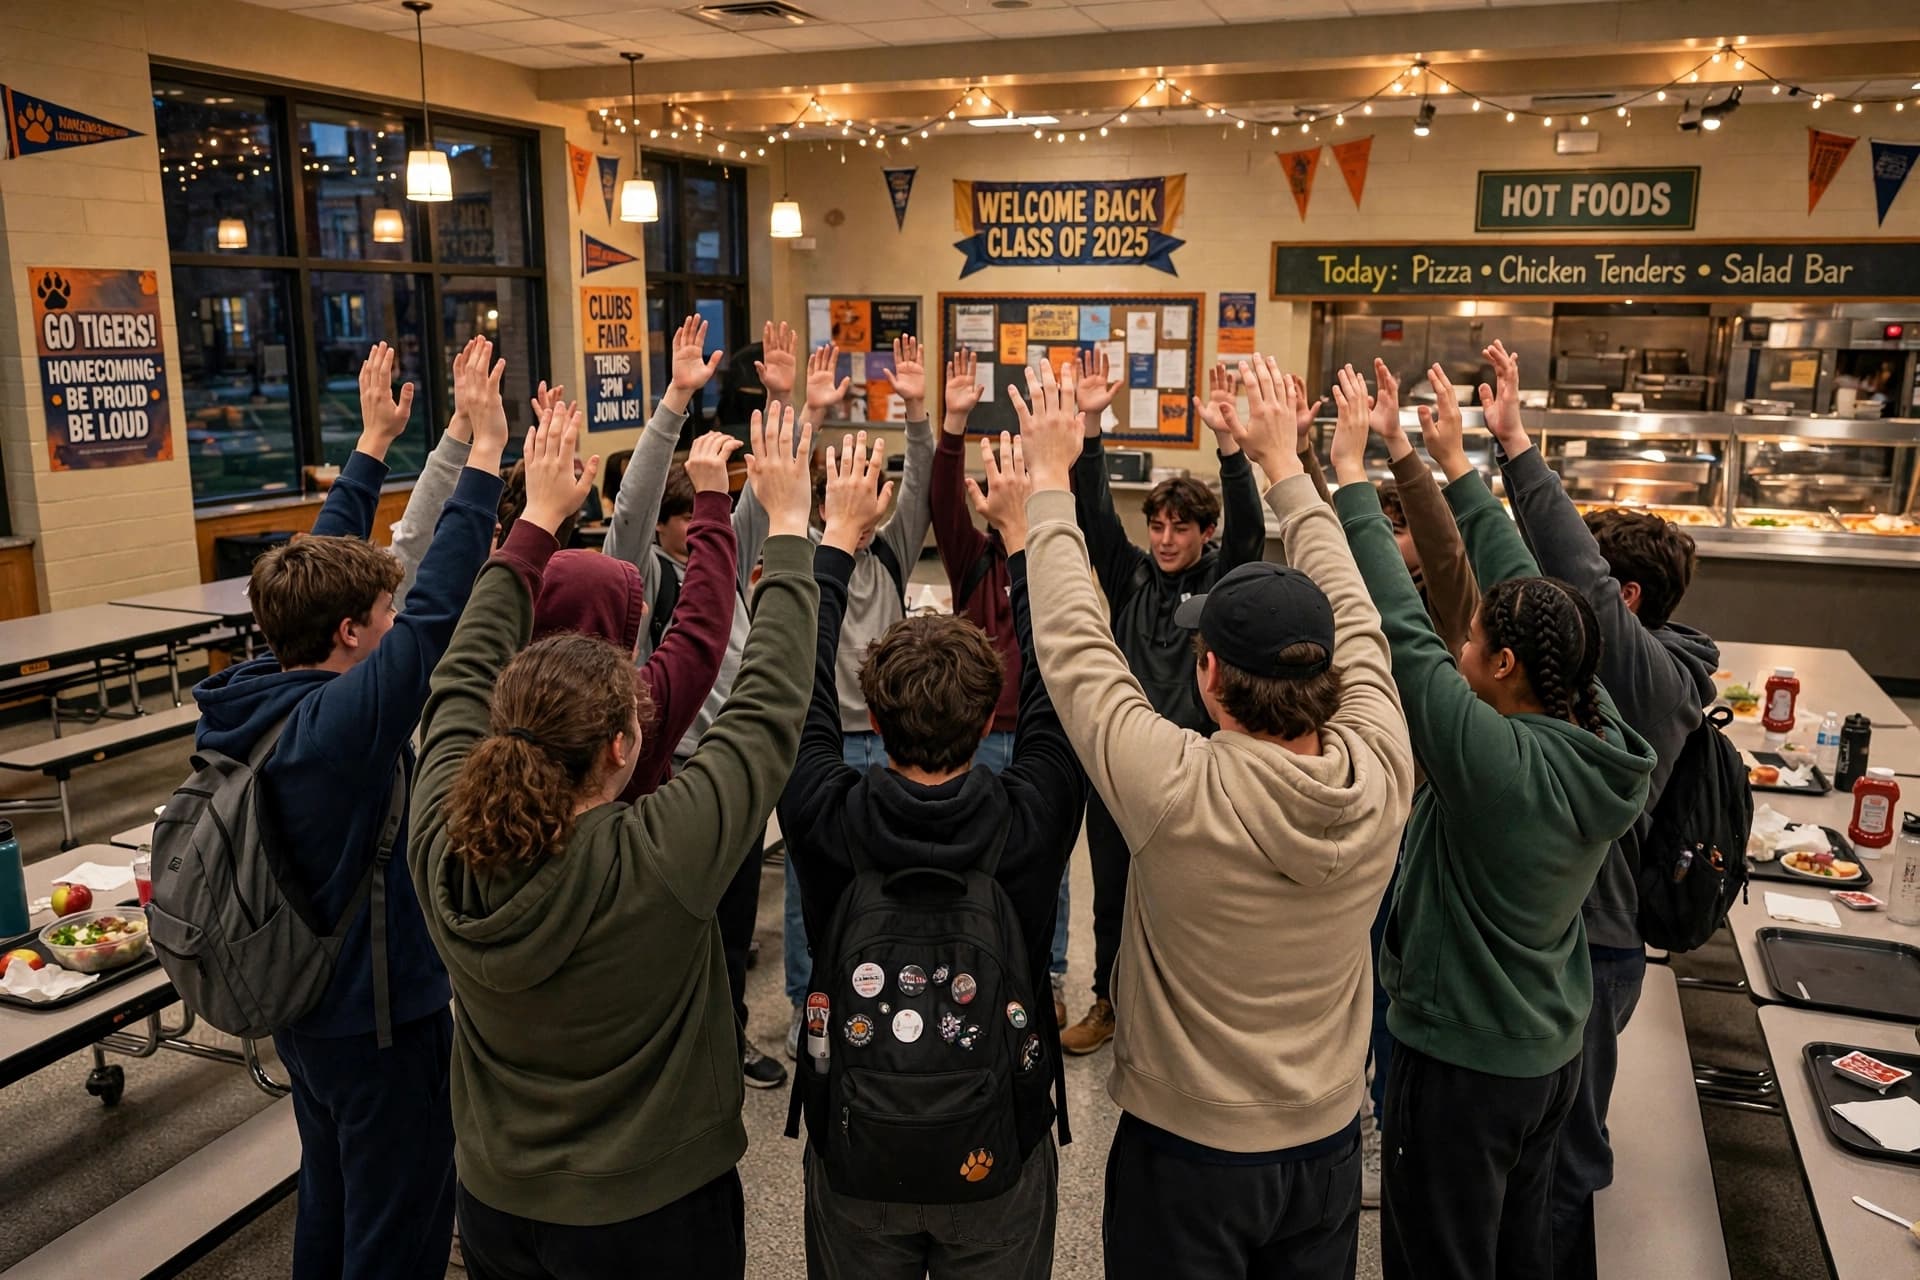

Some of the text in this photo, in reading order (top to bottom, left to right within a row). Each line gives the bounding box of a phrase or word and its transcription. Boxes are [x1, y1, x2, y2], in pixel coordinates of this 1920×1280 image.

[977, 188, 1158, 224] WELCOME BACK
[1501, 182, 1672, 217] HOT FOODS
[987, 226, 1149, 258] CLASS OF 2025
[1317, 253, 1854, 293] Today: Pizza Chicken Tenders Salad Bar
[589, 295, 633, 321] CLUBS
[44, 313, 157, 350] GO TIGERS!
[597, 324, 629, 348] FAIR
[47, 358, 156, 385] HOMECOMING
[593, 355, 631, 375] THURS
[65, 385, 148, 411] BE PROUD
[600, 377, 624, 398] 3PM
[593, 399, 640, 423] JOIN US!
[67, 410, 149, 443] BE LOUD
